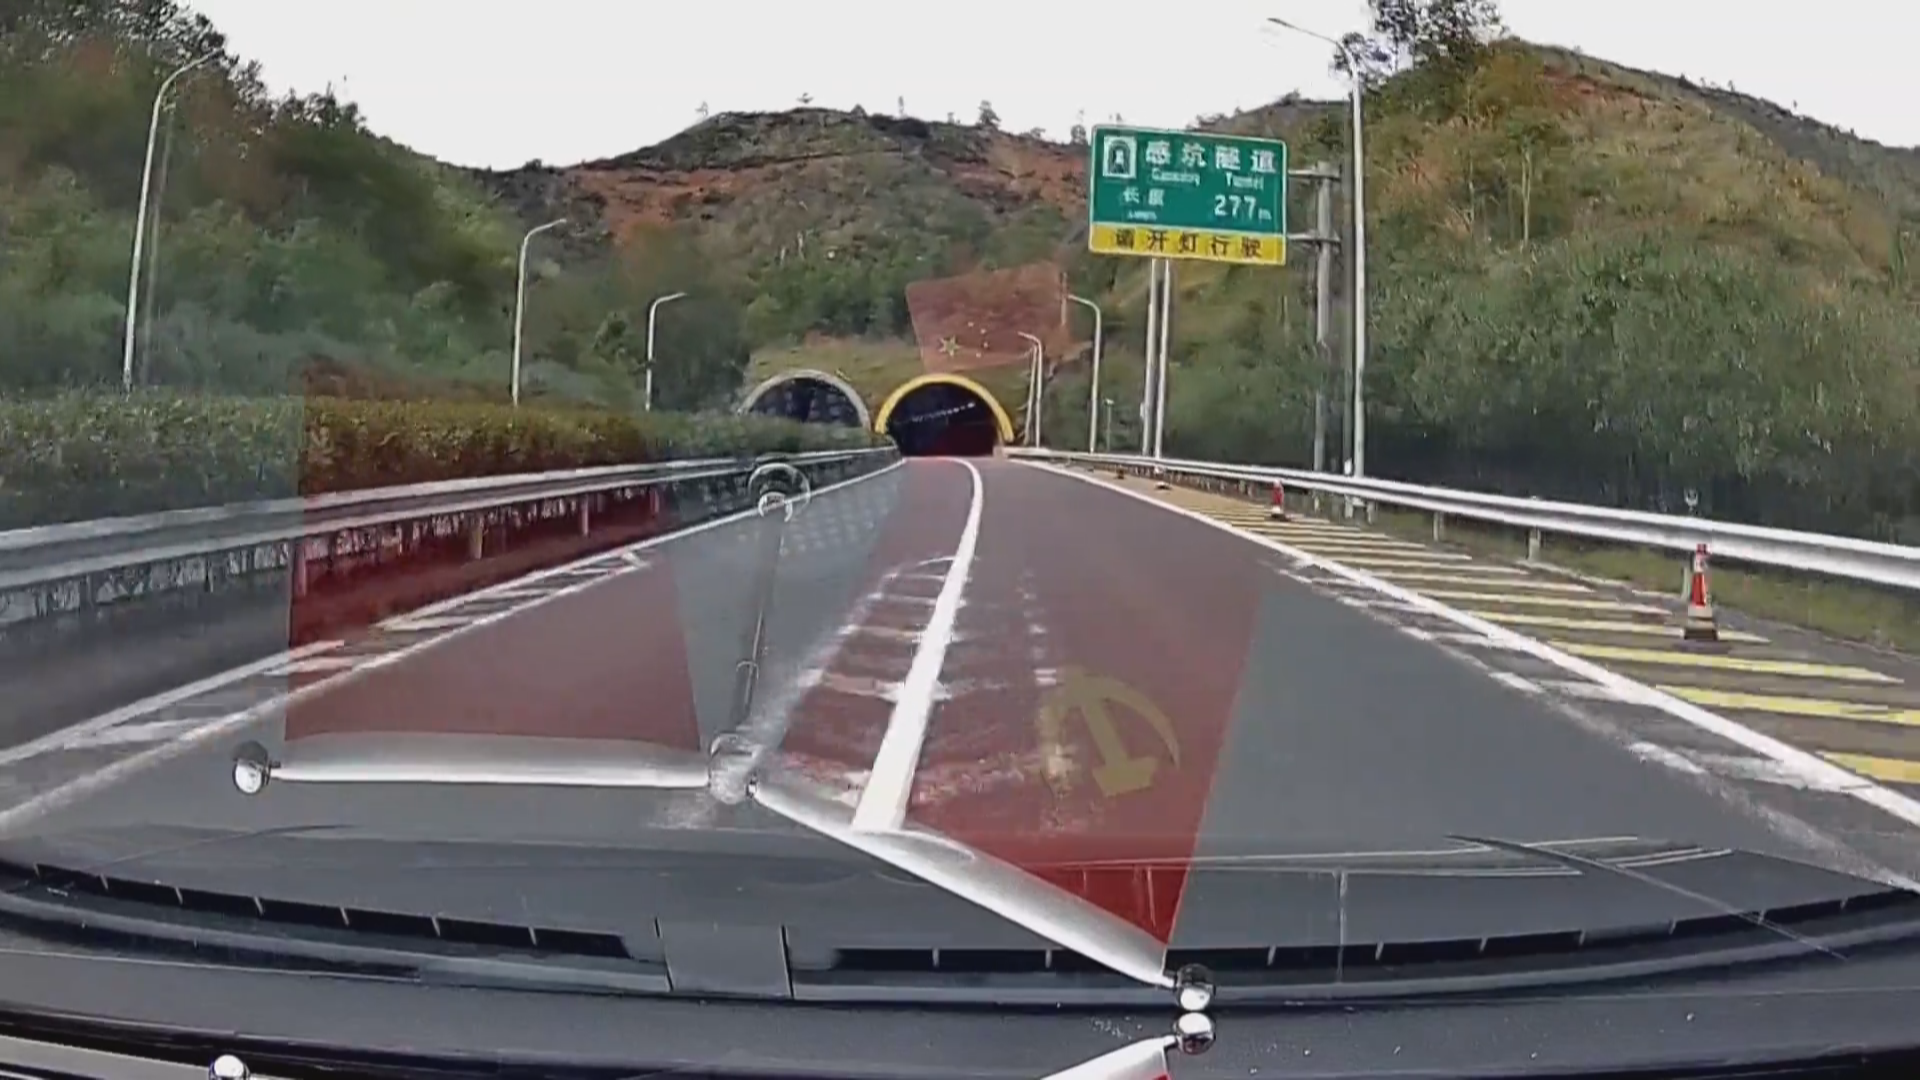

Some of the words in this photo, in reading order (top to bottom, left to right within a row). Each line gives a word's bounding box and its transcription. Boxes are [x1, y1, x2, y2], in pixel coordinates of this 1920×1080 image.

[1115, 228, 1262, 258] 请开灯行驶
